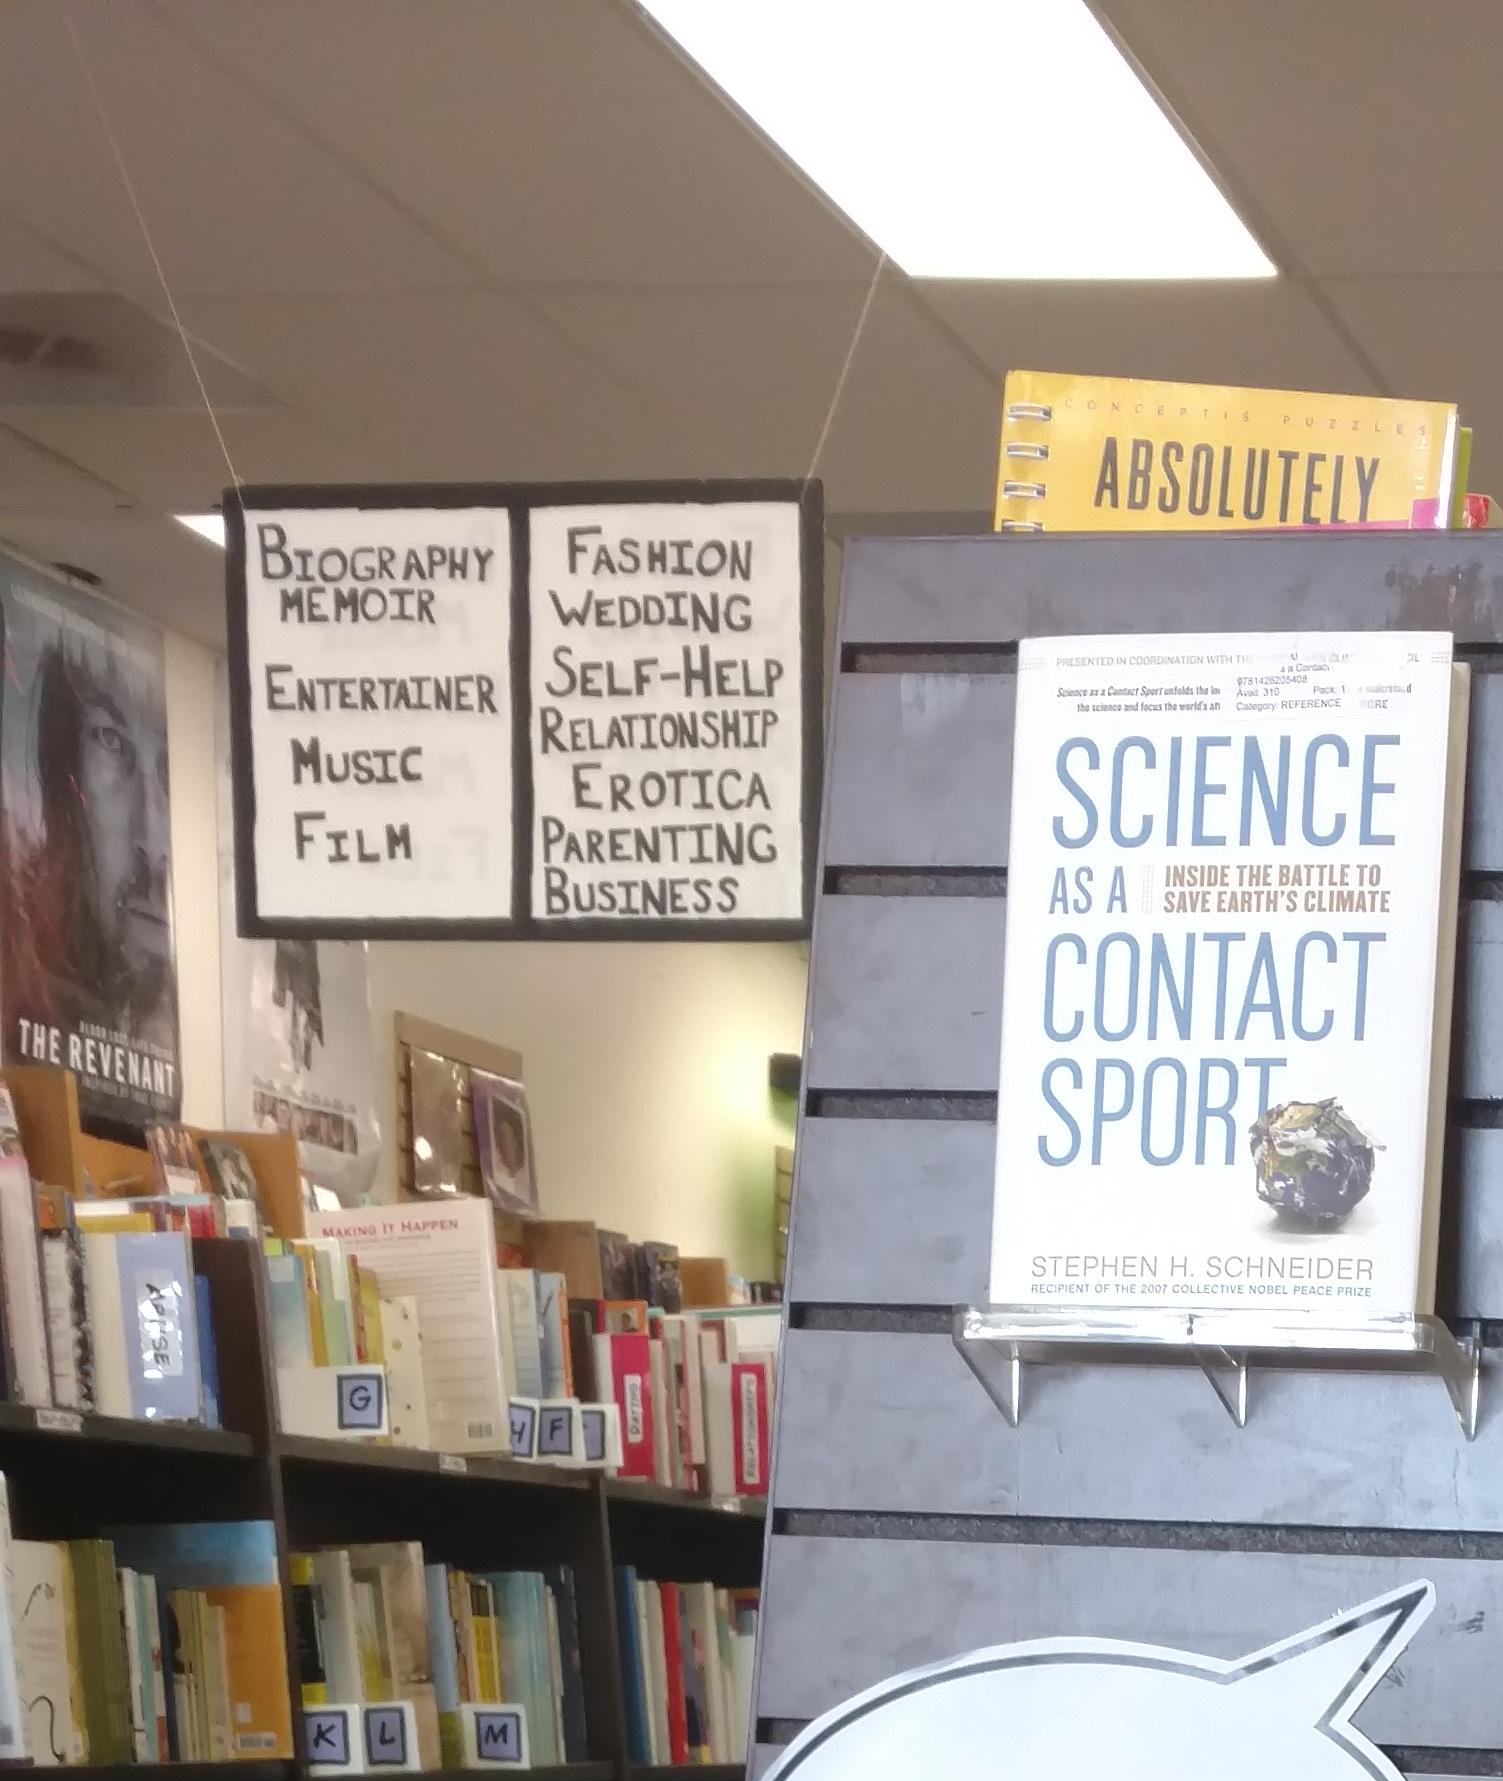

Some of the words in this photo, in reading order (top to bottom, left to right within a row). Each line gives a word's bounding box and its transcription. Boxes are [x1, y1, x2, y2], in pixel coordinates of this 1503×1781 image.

[1064, 398, 1250, 424] CONCEPTIS
[1283, 415, 1428, 437] PUZZLES
[1094, 436, 1380, 525] ABSOLUTELY
[258, 522, 494, 583] BIOGRAPHY
[567, 526, 752, 581] FASHION
[280, 587, 436, 624] MEMOIR
[549, 590, 752, 632] WEDDING
[265, 664, 497, 715] ENTERTAINER
[545, 646, 784, 698] SELF-HELP
[541, 707, 779, 754] RELATIONSHIP
[291, 737, 422, 784] MUSIC
[573, 763, 772, 812] EROTICA
[1052, 733, 1401, 850] SCIENCE
[294, 812, 412, 863] FILM
[542, 817, 777, 865] PARENTING
[545, 868, 737, 915] BUSINESS
[1049, 866, 1093, 914] AS
[1106, 866, 1128, 914] A
[1164, 864, 1230, 888] INSIDE
[1236, 864, 1272, 888] THE
[1277, 864, 1350, 888] BATTLE
[1355, 864, 1382, 888] TO
[1163, 890, 1211, 914] SAVE
[1217, 890, 1298, 914] EARTH'S
[1304, 890, 1391, 914] CLIMATE
[1043, 931, 1387, 1042] CONTACT
[19, 1018, 61, 1065] THE
[68, 1033, 175, 1098] REVENANT
[1037, 1057, 1288, 1167] SPORT
[322, 1222, 376, 1238] MAKING
[381, 1220, 397, 1236] IT
[401, 1216, 459, 1234] HAPPEN
[1031, 1256, 1157, 1278] STEPHEN
[1170, 1257, 1193, 1279] H.
[1206, 1257, 1373, 1281] SCHNEIDER
[350, 1386, 371, 1412] G
